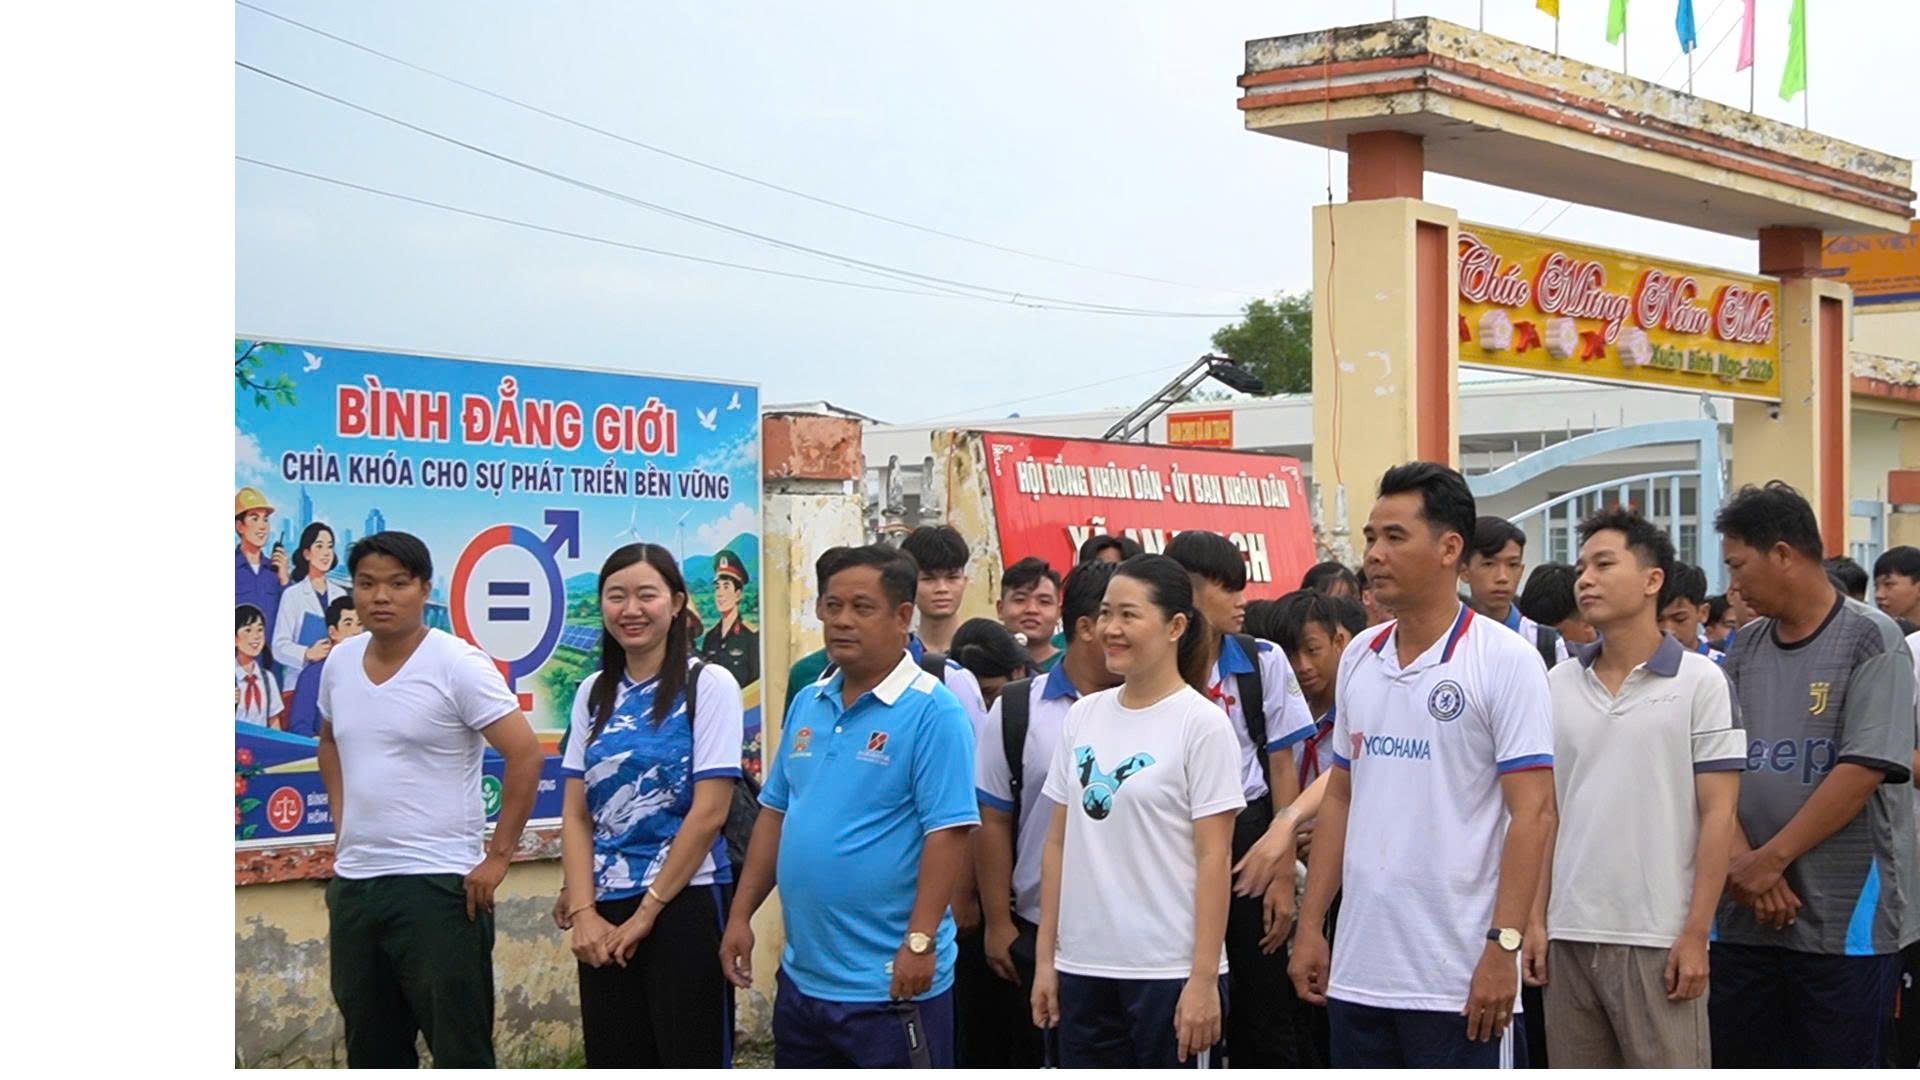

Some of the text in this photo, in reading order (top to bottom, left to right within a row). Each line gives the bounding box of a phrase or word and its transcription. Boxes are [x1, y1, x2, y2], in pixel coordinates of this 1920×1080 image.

[337, 375, 677, 455] BÌNH ĐẲNG GIỚI
[282, 447, 730, 500] CHÌA KHÓA CHO SỰ PHÁT TRIỂN BỀN VỮNG
[1016, 455, 1046, 501] HỘI
[1044, 453, 1090, 497] ĐỒNG
[1087, 461, 1133, 499] NHÂN
[1130, 463, 1164, 501] DÂN
[1171, 463, 1192, 503] ỦY
[1191, 473, 1223, 505] BAN
[1222, 470, 1262, 507] NHÂN
[1260, 472, 1290, 509] DÂN
[1746, 737, 1838, 785] eep
